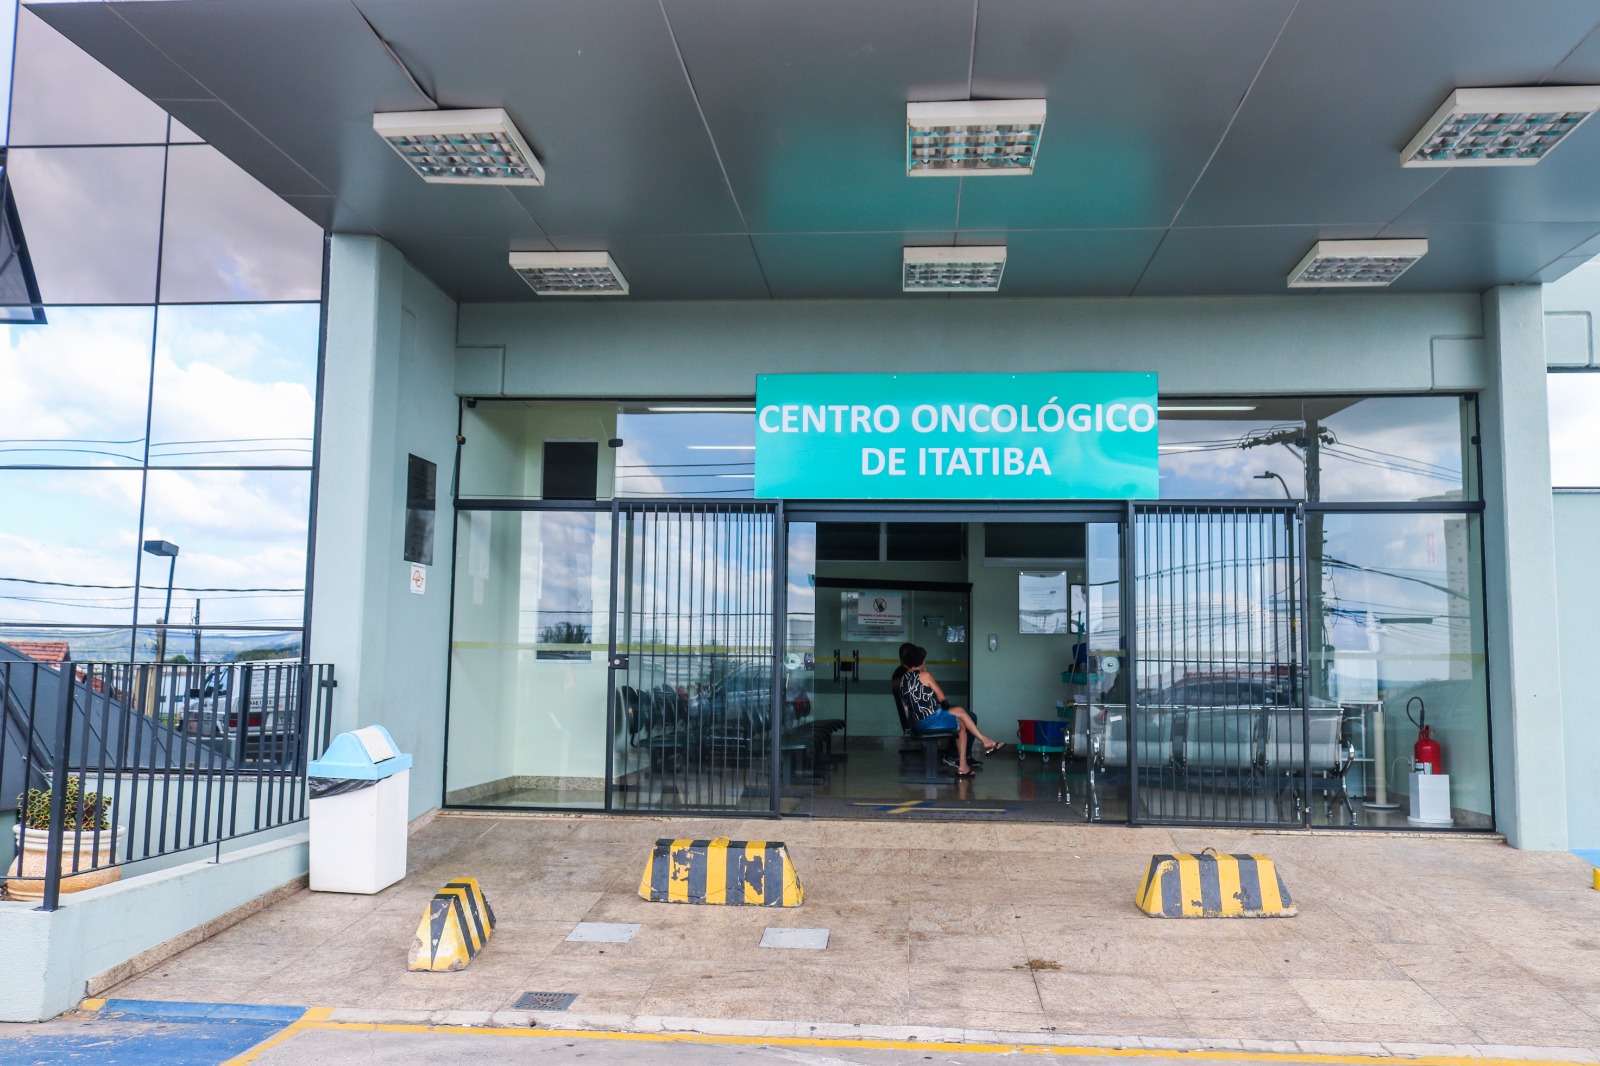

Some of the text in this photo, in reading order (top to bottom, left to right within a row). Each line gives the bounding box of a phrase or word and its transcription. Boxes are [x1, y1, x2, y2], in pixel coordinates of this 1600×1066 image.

[758, 396, 1156, 433] CENTRO ONCOLÓGICO
[861, 447, 1052, 475] DE ITATIBA
